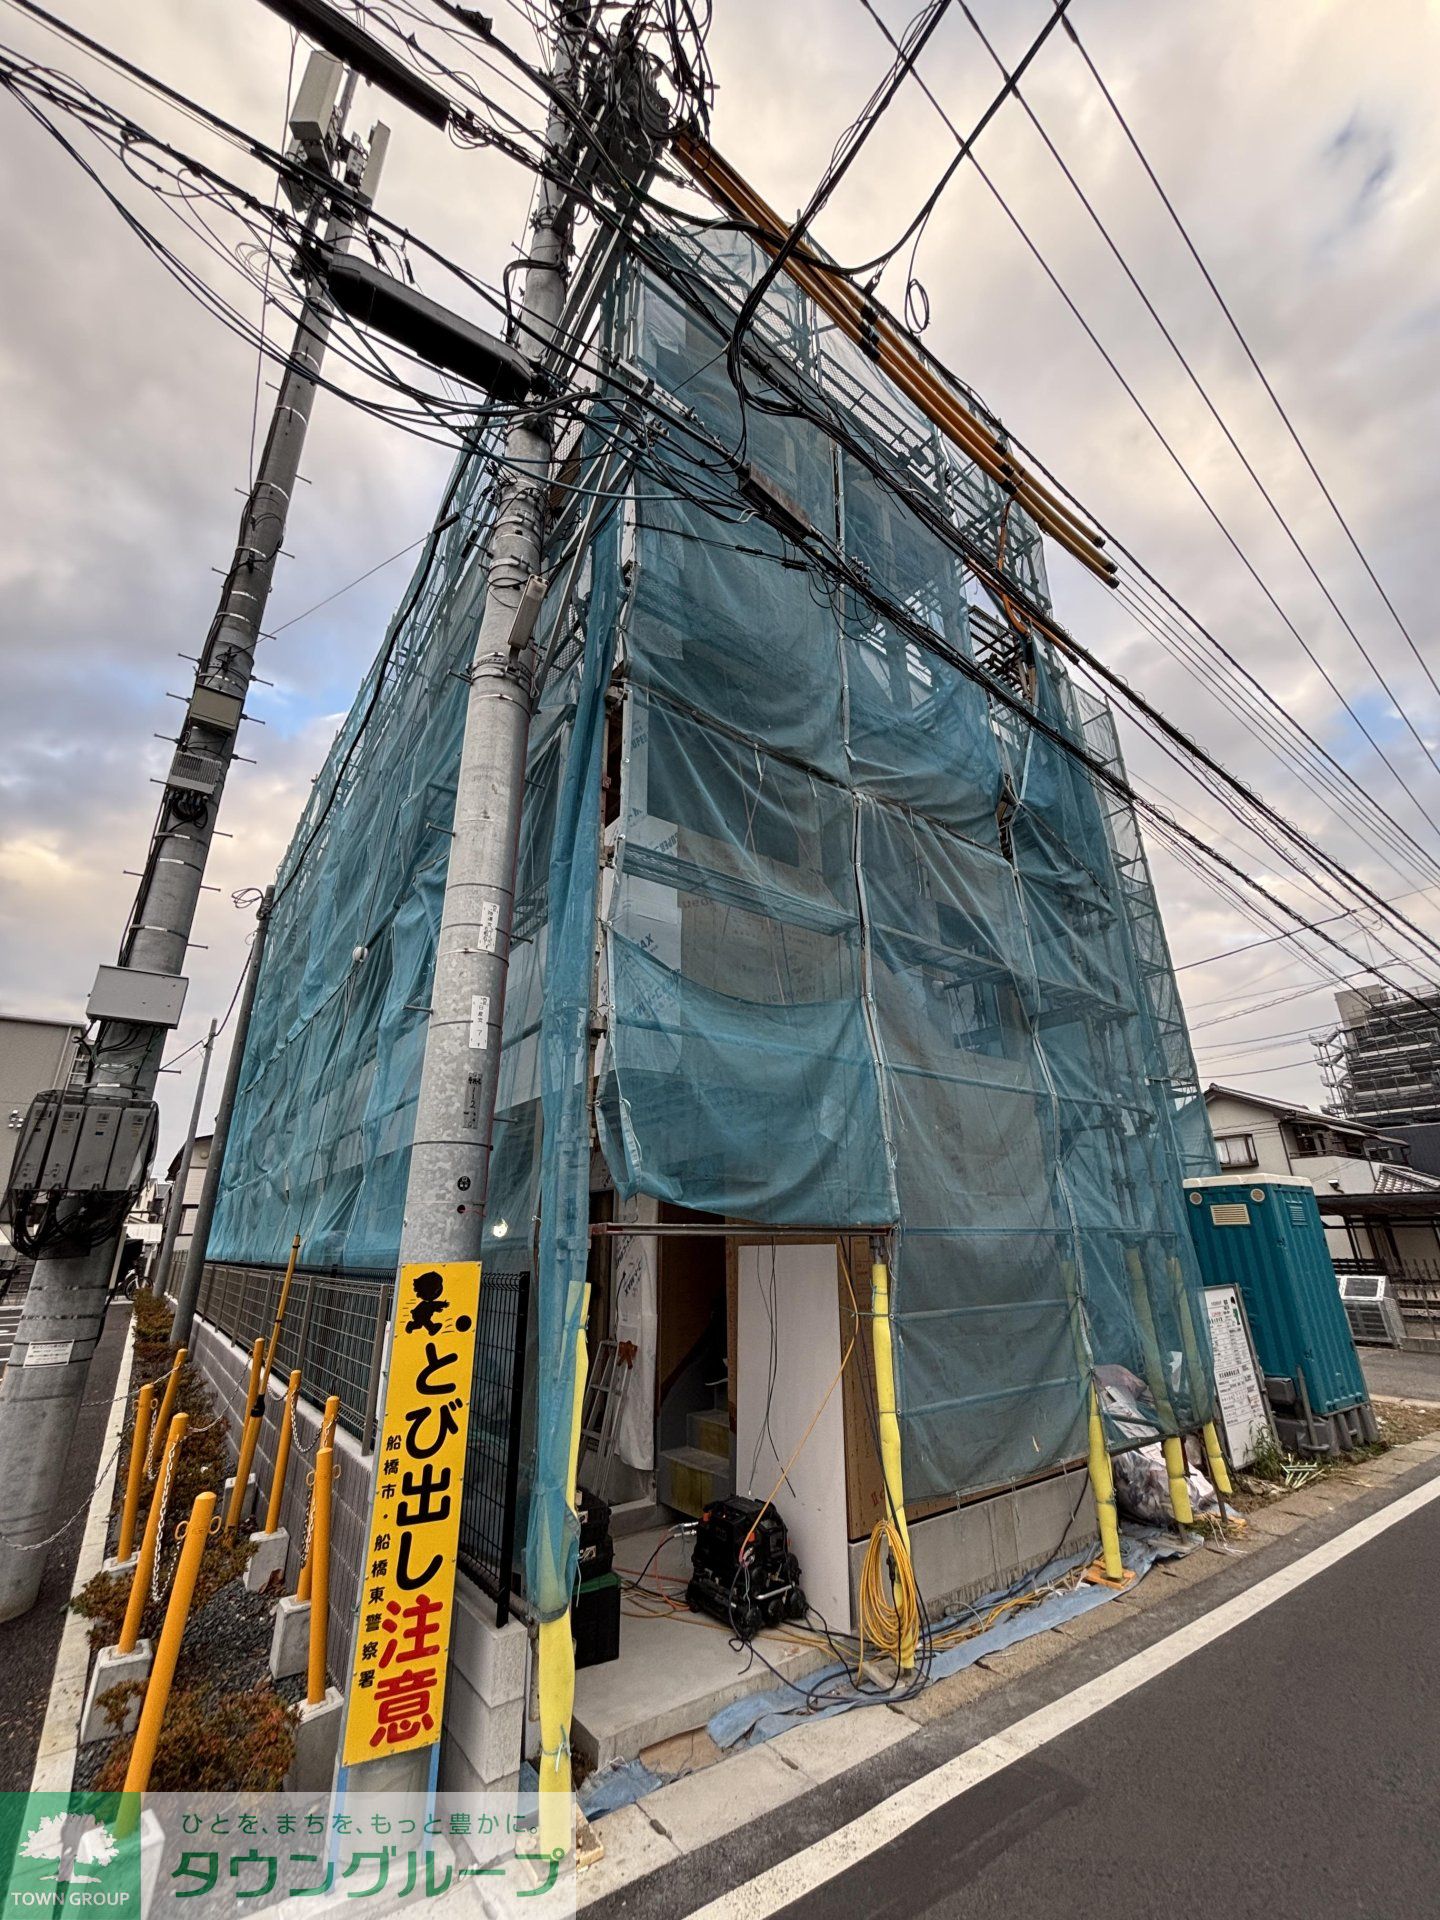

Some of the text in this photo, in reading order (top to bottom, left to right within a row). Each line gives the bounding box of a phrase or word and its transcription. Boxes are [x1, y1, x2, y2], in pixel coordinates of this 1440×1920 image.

[358, 1435, 402, 1688] 船橋市・船橋東警察署
[369, 1342, 463, 1748] とび出し注意
